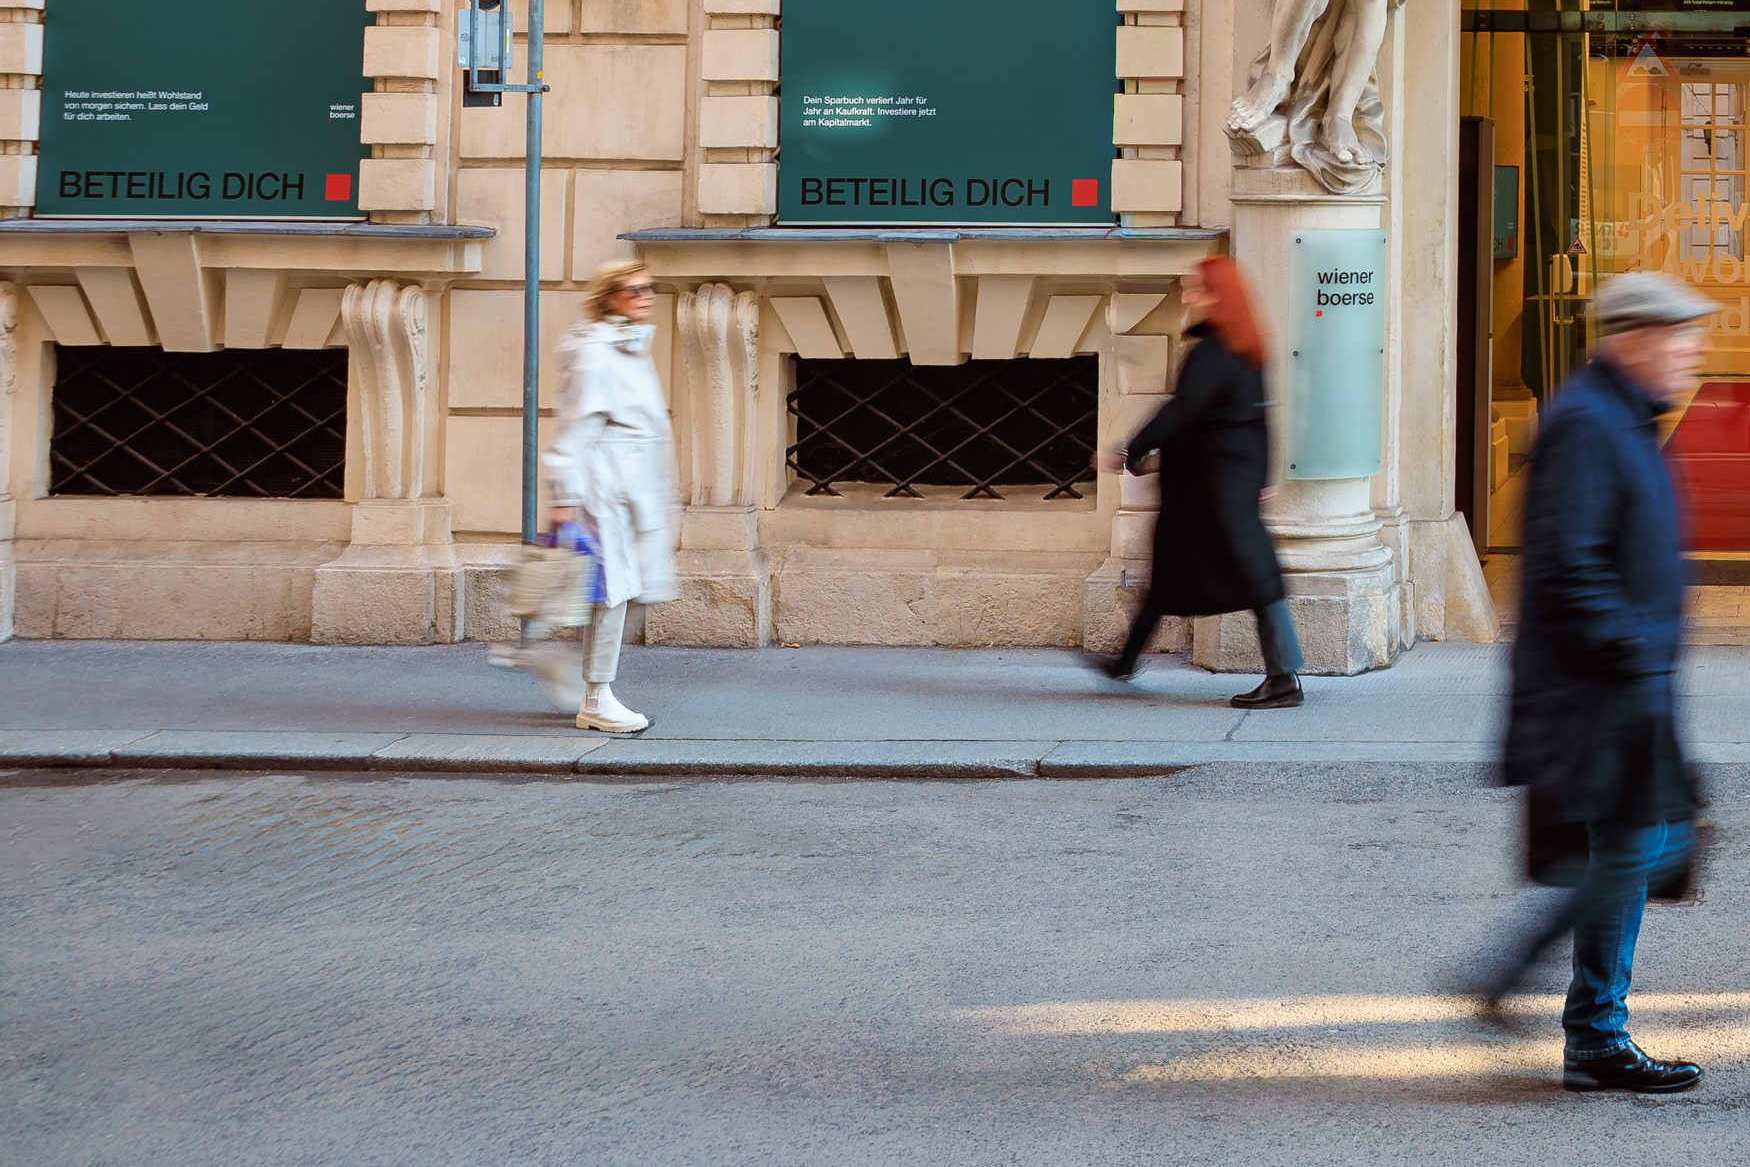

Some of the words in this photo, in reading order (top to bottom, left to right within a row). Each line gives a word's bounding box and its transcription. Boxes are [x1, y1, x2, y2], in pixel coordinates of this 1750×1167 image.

[64, 90, 90, 99] Heute
[91, 90, 135, 99] investieren
[136, 90, 157, 99] heißt
[158, 91, 202, 100] Wohlstand
[803, 95, 823, 105] Dein
[823, 95, 865, 106] Sparbuch
[865, 96, 894, 105] verliert
[895, 96, 914, 105] Jahr
[915, 96, 928, 105] für
[64, 102, 80, 110] von
[81, 102, 113, 112] morgen
[114, 101, 147, 110] sichern.
[147, 102, 168, 111] Lass
[168, 102, 188, 111] dein
[188, 101, 209, 111] Geld
[329, 103, 355, 111] wiener
[803, 107, 822, 116] Jahr
[823, 108, 834, 116] an
[835, 106, 876, 116] Kaufkraft.
[877, 107, 917, 116] Investiere
[918, 108, 937, 118] jetzt
[63, 111, 76, 121] für
[76, 112, 95, 121] dich
[95, 112, 132, 121] arbeiten.
[329, 111, 356, 119] boerse
[818, 117, 872, 128] Kapitalmarkt.
[59, 170, 211, 200] BETEILIG
[222, 172, 305, 201] DICH
[801, 177, 954, 207] BETEILIG
[966, 178, 1050, 207] DICH
[1317, 267, 1374, 285] wiener
[1317, 288, 1374, 306] boerse
